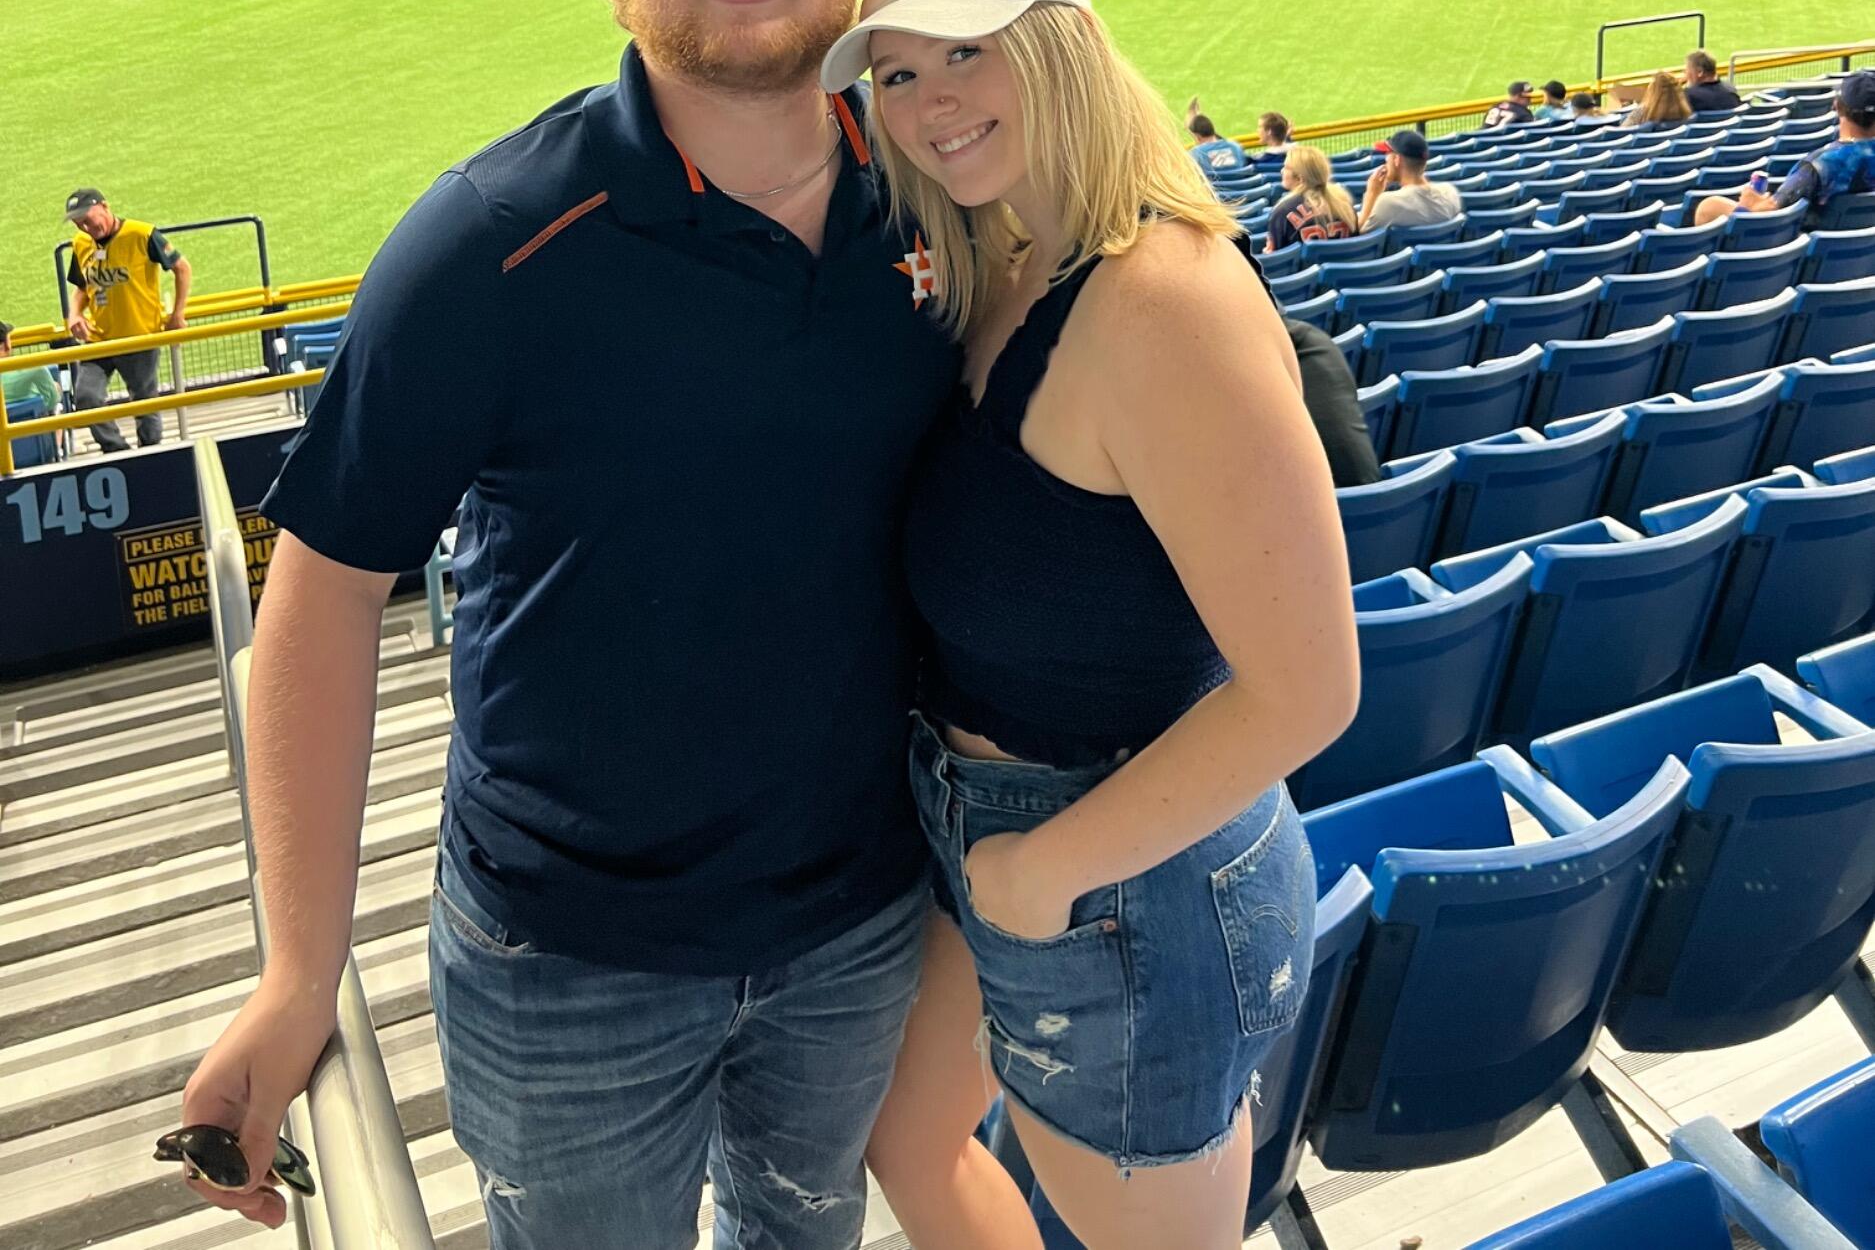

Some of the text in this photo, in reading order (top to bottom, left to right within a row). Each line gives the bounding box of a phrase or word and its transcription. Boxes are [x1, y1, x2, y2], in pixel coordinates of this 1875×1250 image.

[5, 466, 130, 545] 149
[131, 530, 195, 557] PLEASE
[129, 552, 208, 590] WATC
[132, 581, 209, 609] FOR BALL
[133, 599, 209, 626] THE FIEL
